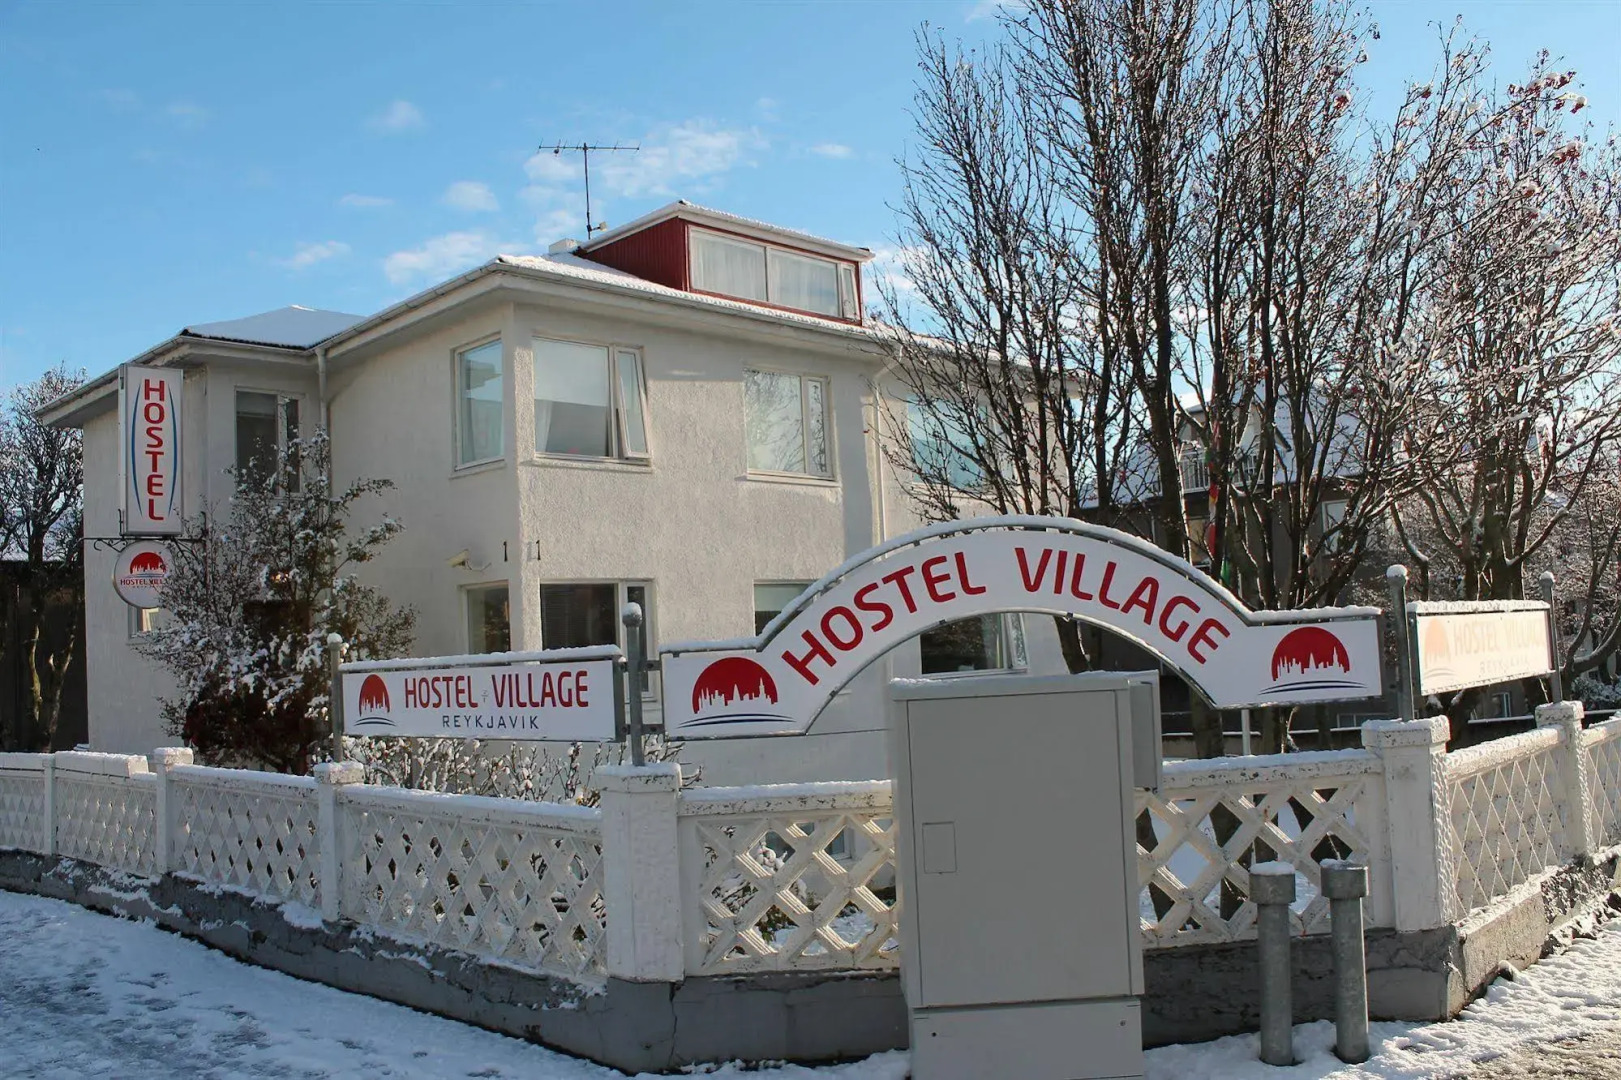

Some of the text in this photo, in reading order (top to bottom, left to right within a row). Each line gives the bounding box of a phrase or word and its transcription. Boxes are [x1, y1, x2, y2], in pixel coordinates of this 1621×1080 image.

[144, 379, 165, 521] HOSTEL
[120, 578, 147, 586] HOSTEL
[781, 547, 1230, 686] HOSTEL VILLAGE
[405, 670, 589, 709] HOSTEL VILLAGE
[442, 714, 540, 730] REYKJAVIK
